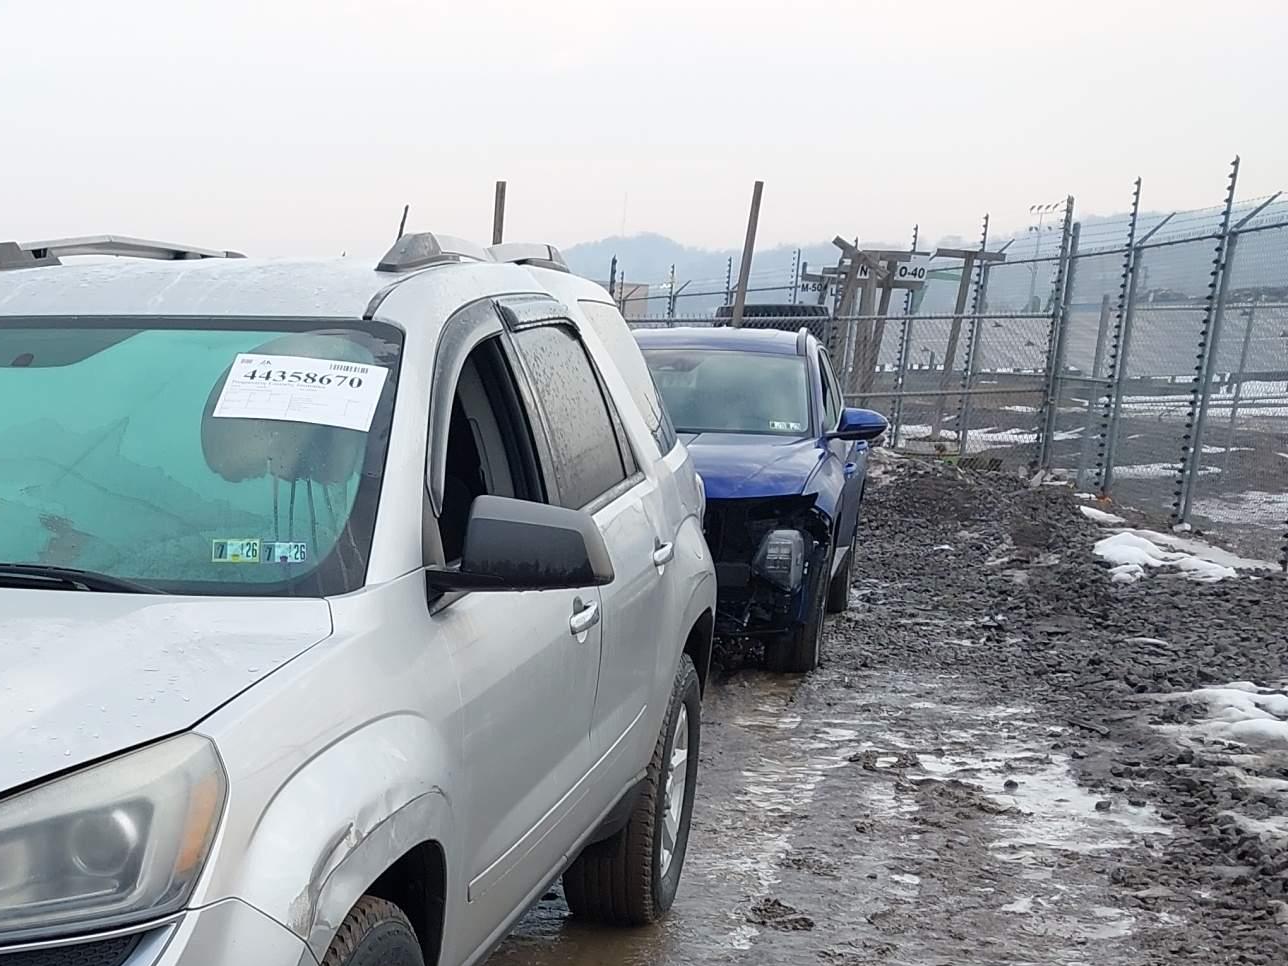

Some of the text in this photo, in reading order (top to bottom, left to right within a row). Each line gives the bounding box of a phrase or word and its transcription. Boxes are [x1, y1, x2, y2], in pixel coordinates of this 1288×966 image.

[898, 266, 925, 279] O-40
[243, 369, 364, 389] 44358670
[245, 542, 258, 558] 26
[294, 544, 306, 560] 26
